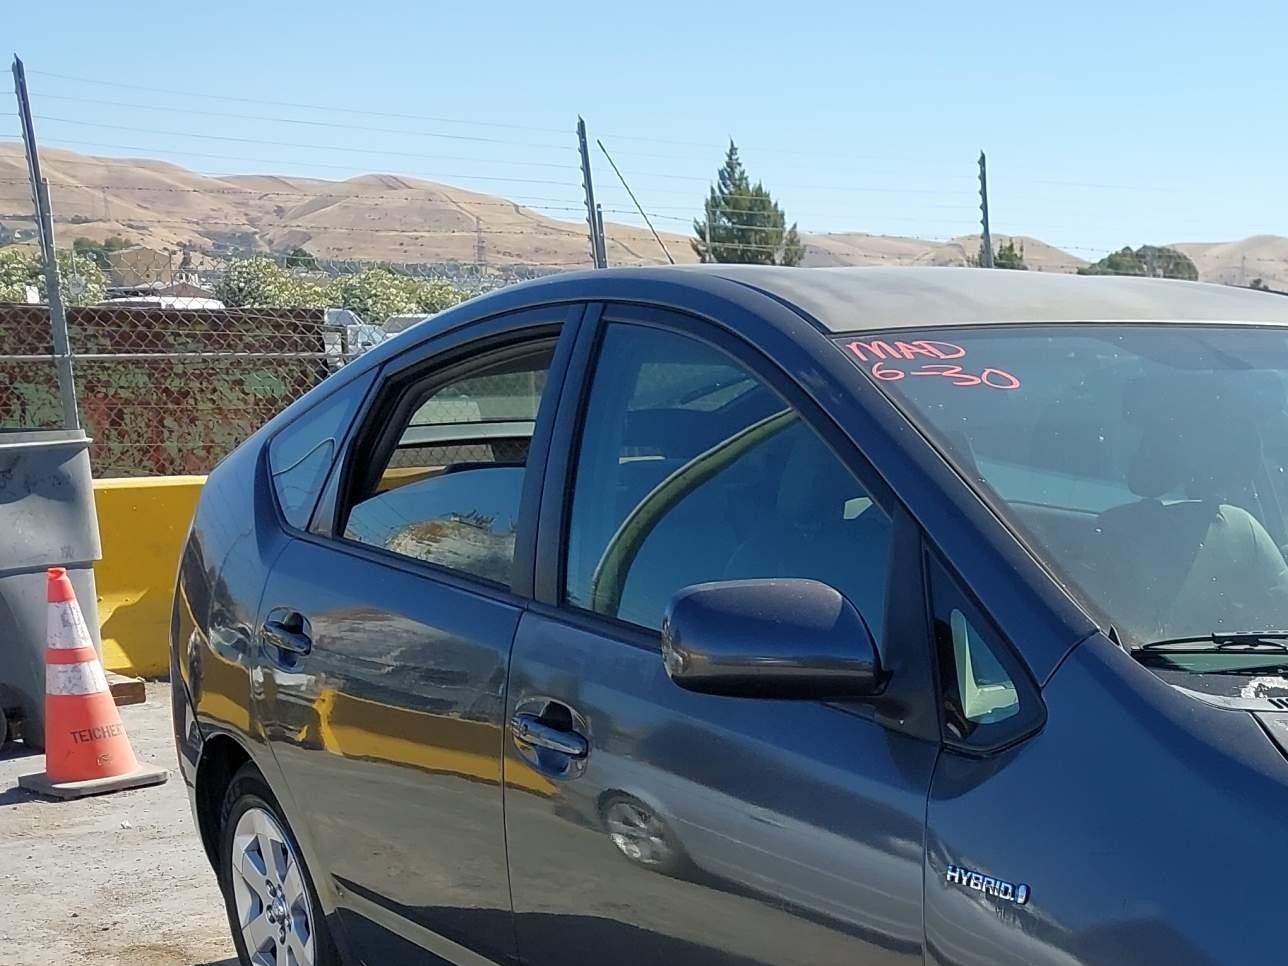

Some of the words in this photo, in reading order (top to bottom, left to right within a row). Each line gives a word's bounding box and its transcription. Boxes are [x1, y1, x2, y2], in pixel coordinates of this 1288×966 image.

[846, 340, 966, 362] MAD
[871, 362, 1020, 389] 6-30
[946, 865, 1013, 901] HYBRID
